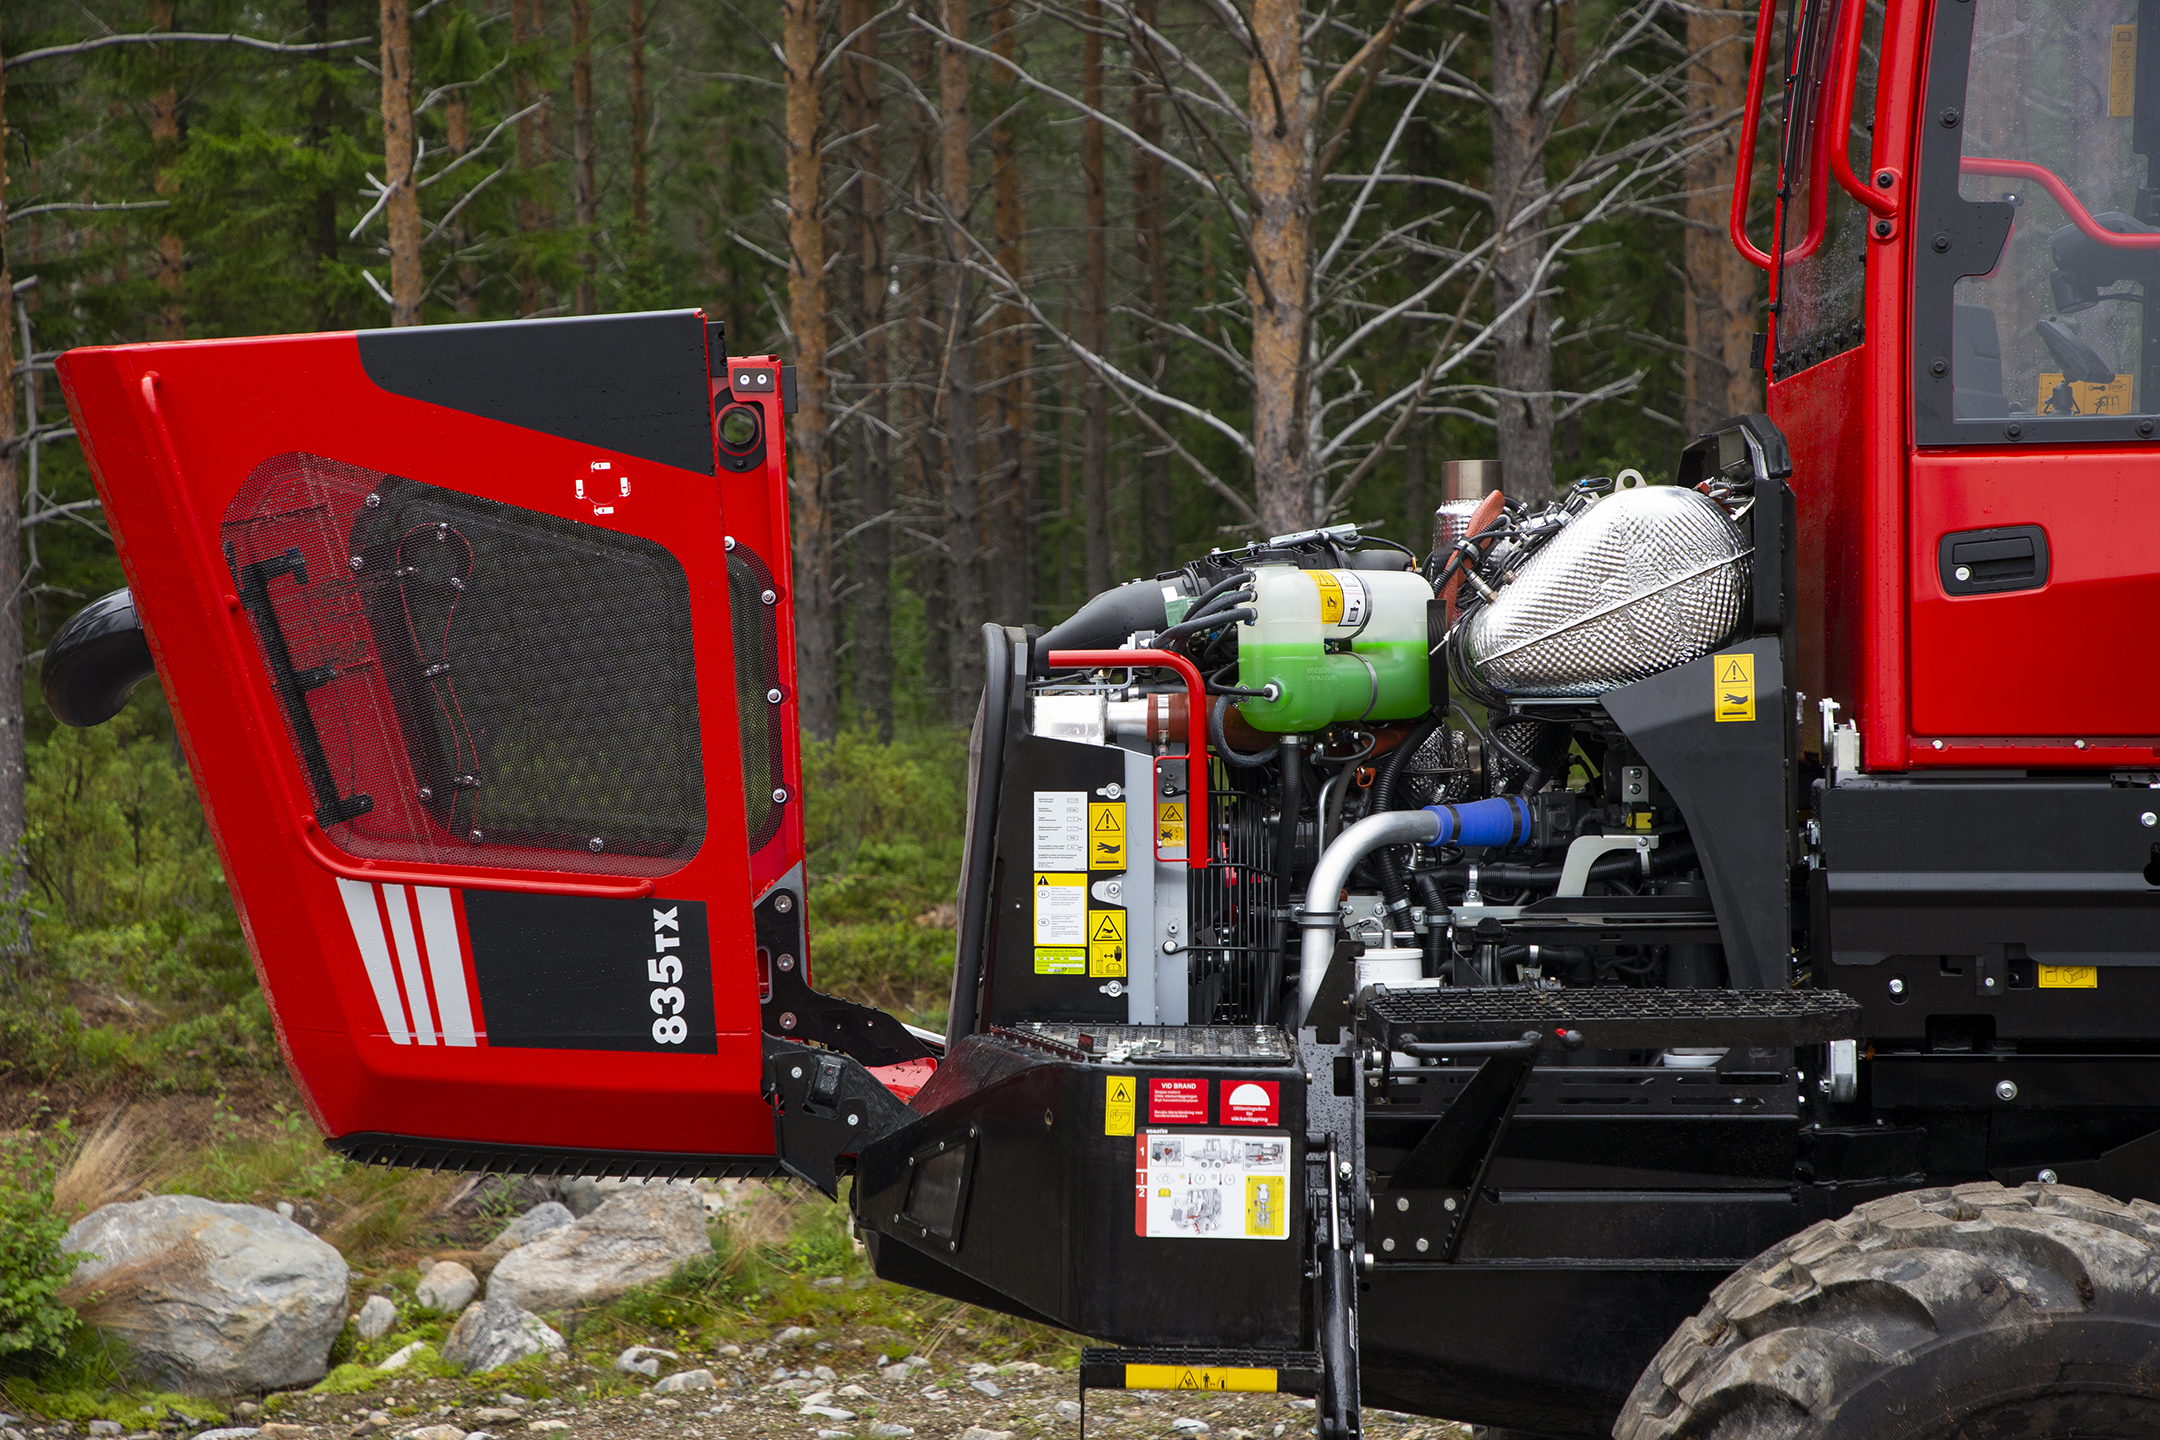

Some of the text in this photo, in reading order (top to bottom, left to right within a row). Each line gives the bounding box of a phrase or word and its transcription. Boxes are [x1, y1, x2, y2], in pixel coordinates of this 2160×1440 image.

[648, 906, 688, 1045] 835TX
[1174, 1082, 1197, 1090] BRAND
[1140, 1147, 1145, 1156] 1
[1139, 1188, 1145, 1197] 2
